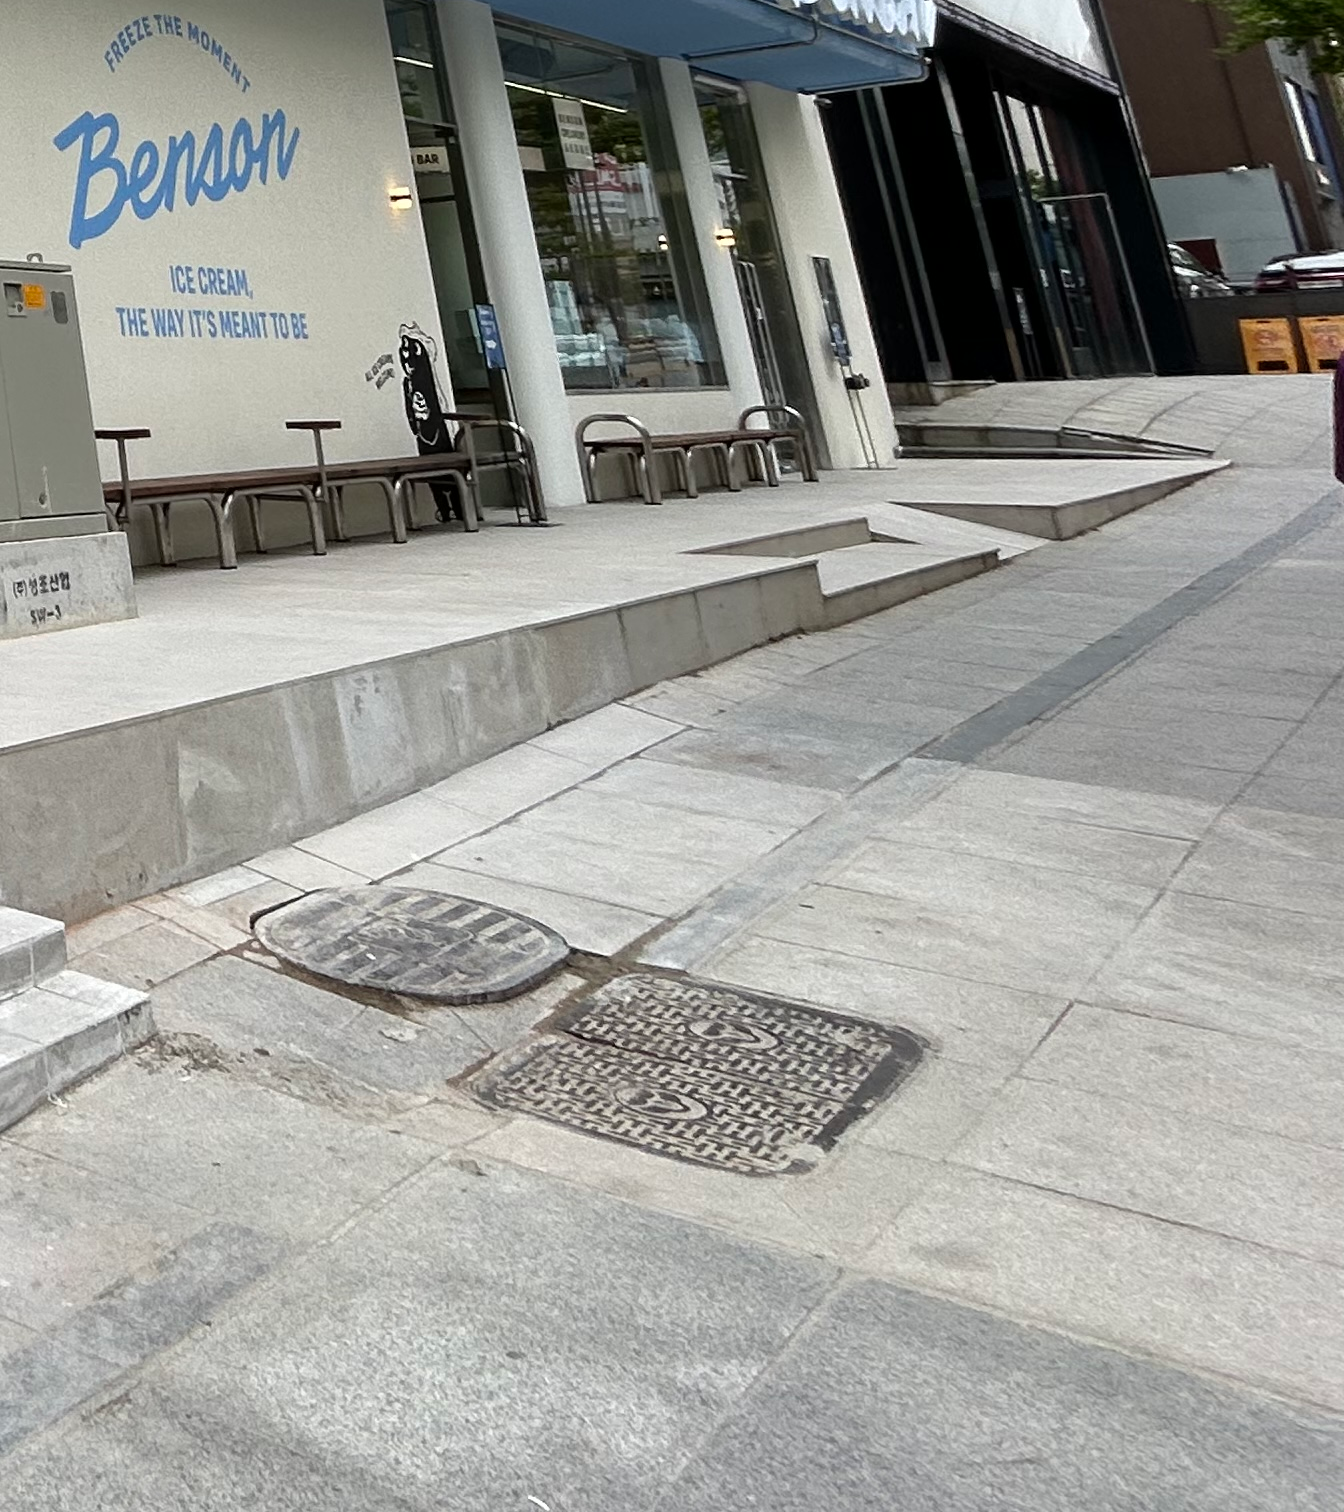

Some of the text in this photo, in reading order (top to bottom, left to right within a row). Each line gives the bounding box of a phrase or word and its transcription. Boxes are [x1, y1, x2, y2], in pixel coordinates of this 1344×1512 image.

[103, 13, 252, 94] FREEZE THE MOMENT
[52, 108, 301, 250] Benson
[169, 265, 254, 300] ICE CREAM,
[116, 307, 309, 341] THE WAY IT'S MEANT TO BE
